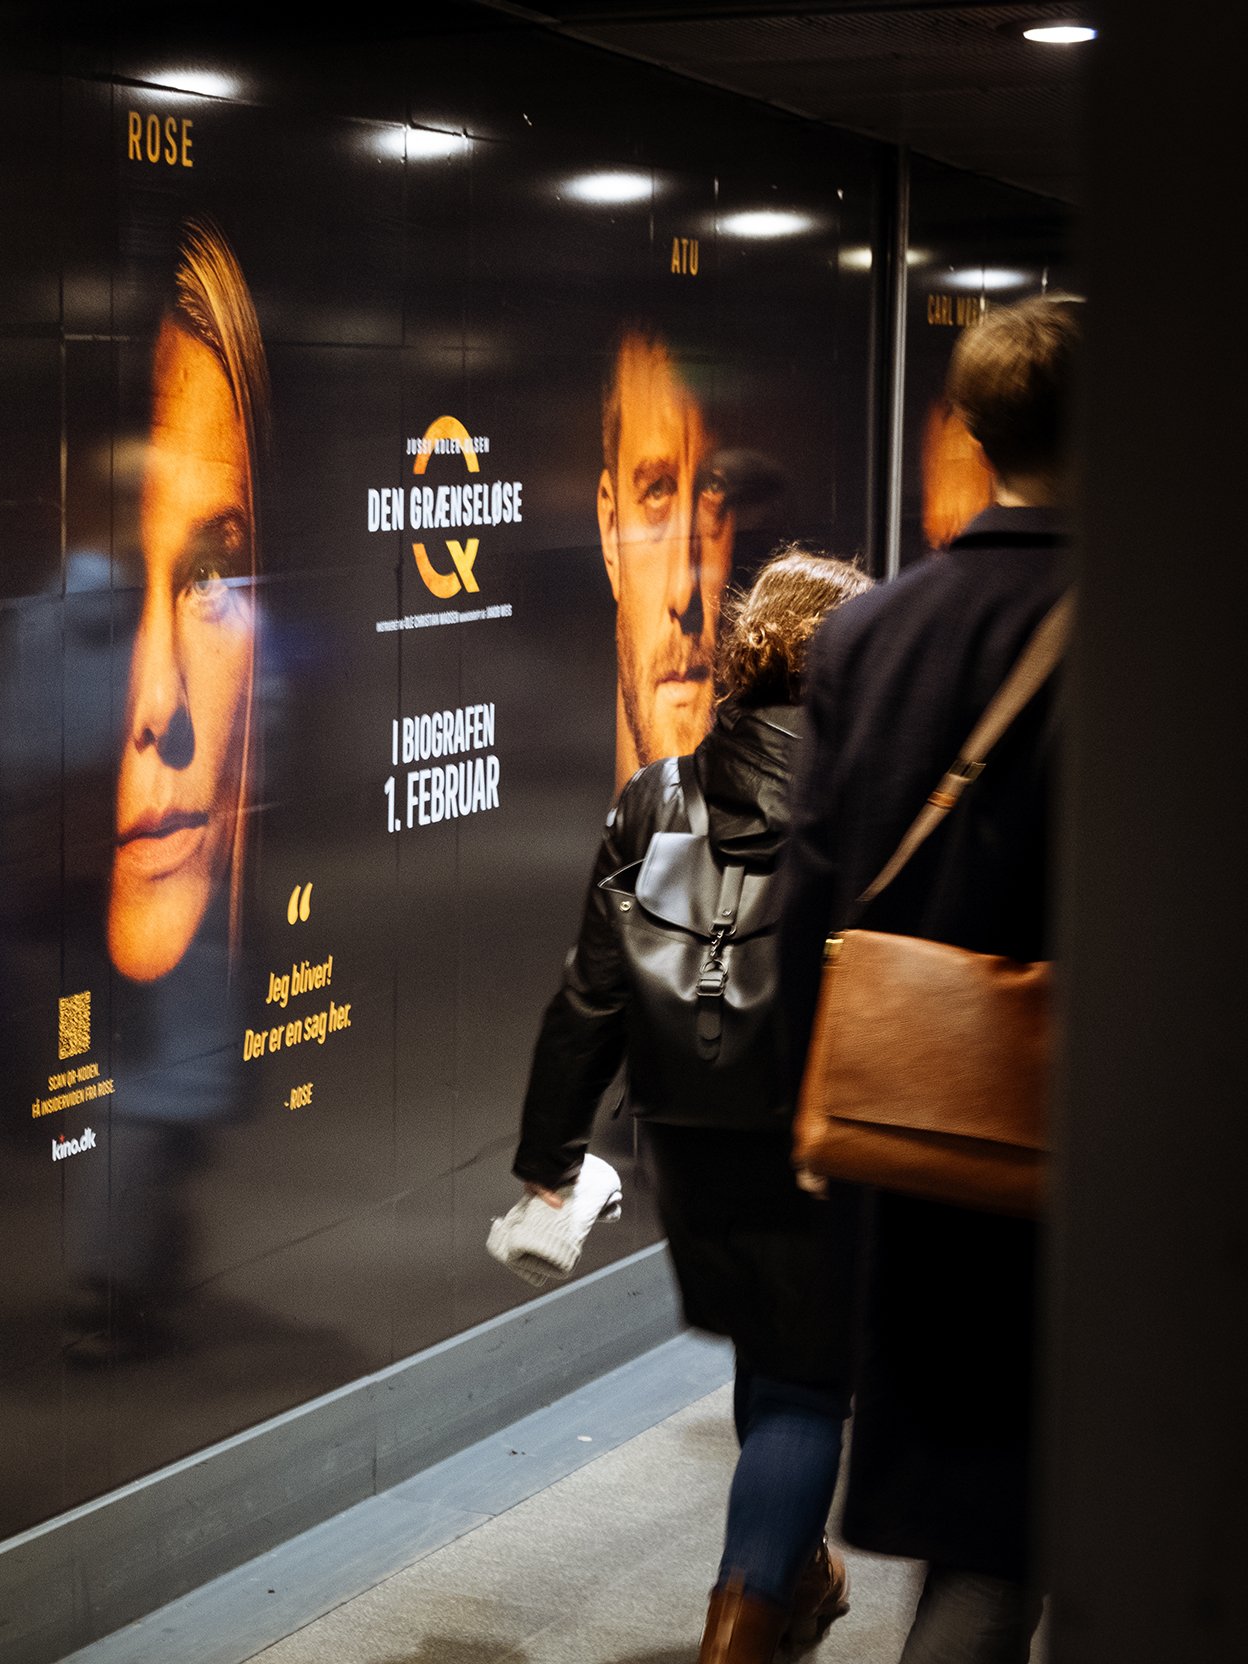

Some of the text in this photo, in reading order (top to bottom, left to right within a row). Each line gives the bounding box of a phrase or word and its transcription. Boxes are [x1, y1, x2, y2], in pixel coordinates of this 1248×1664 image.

[128, 111, 193, 167] ROSE
[671, 237, 699, 276] ATU
[368, 480, 523, 532] DEN GRÆNSELØSE
[392, 702, 495, 766] I BIOGRAFEN
[384, 755, 500, 833] 1. FEBRUAR
[266, 954, 333, 1008] Jeg bliver!
[243, 1001, 352, 1062] Der er en sag her.
[52, 1127, 96, 1161] kino.dk
